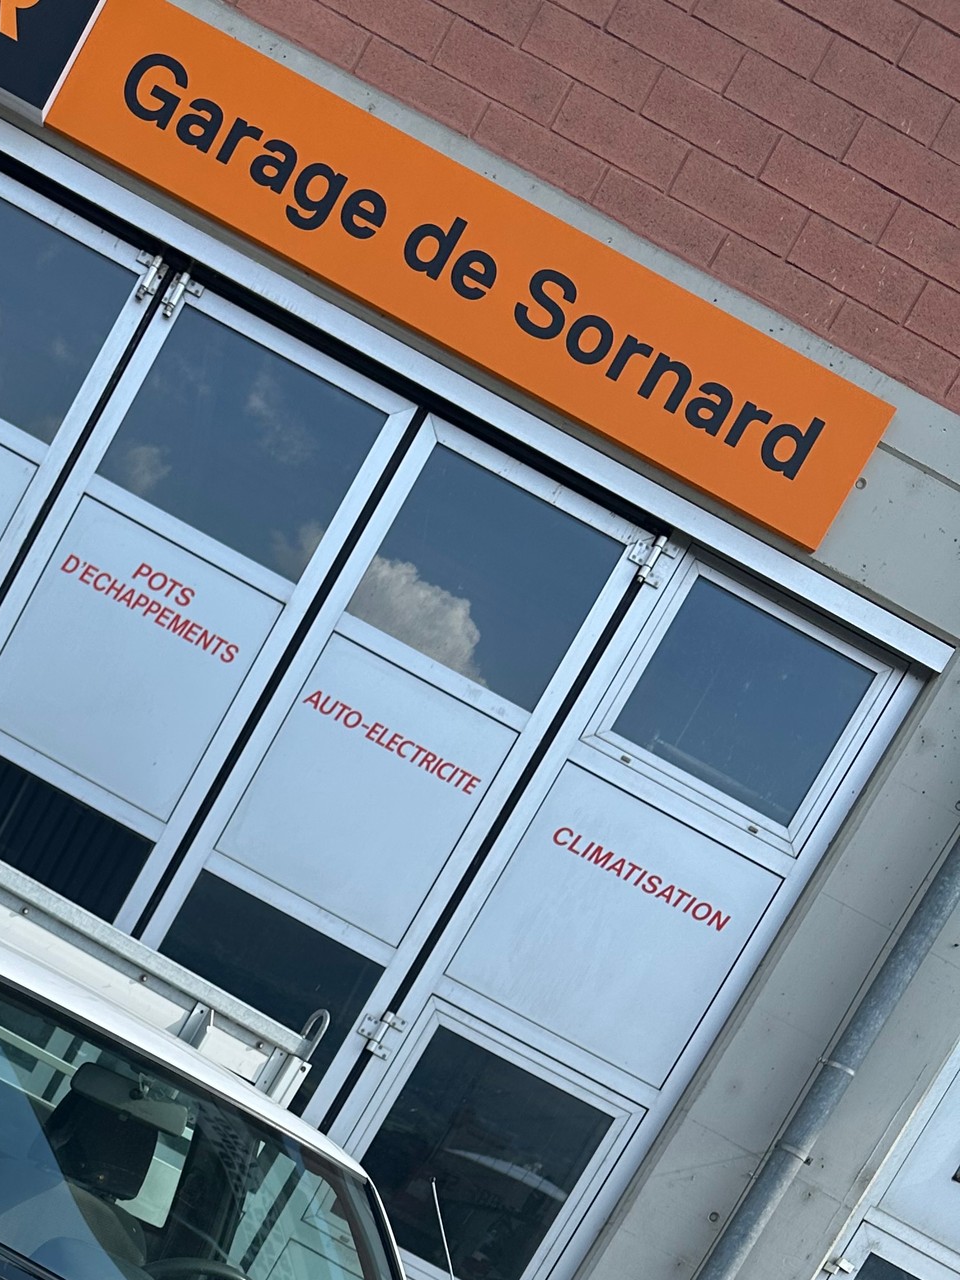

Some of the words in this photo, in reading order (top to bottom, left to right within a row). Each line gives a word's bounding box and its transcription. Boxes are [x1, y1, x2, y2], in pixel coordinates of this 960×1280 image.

[123, 52, 388, 240] Garage
[403, 217, 498, 300] de
[514, 268, 826, 481] Sornard
[60, 553, 240, 664] D'ECHAPPEMENTS
[131, 562, 196, 607] POTS
[302, 690, 482, 795] AUTO-ELECTRICITE
[552, 827, 731, 932] CLIMATISATION
